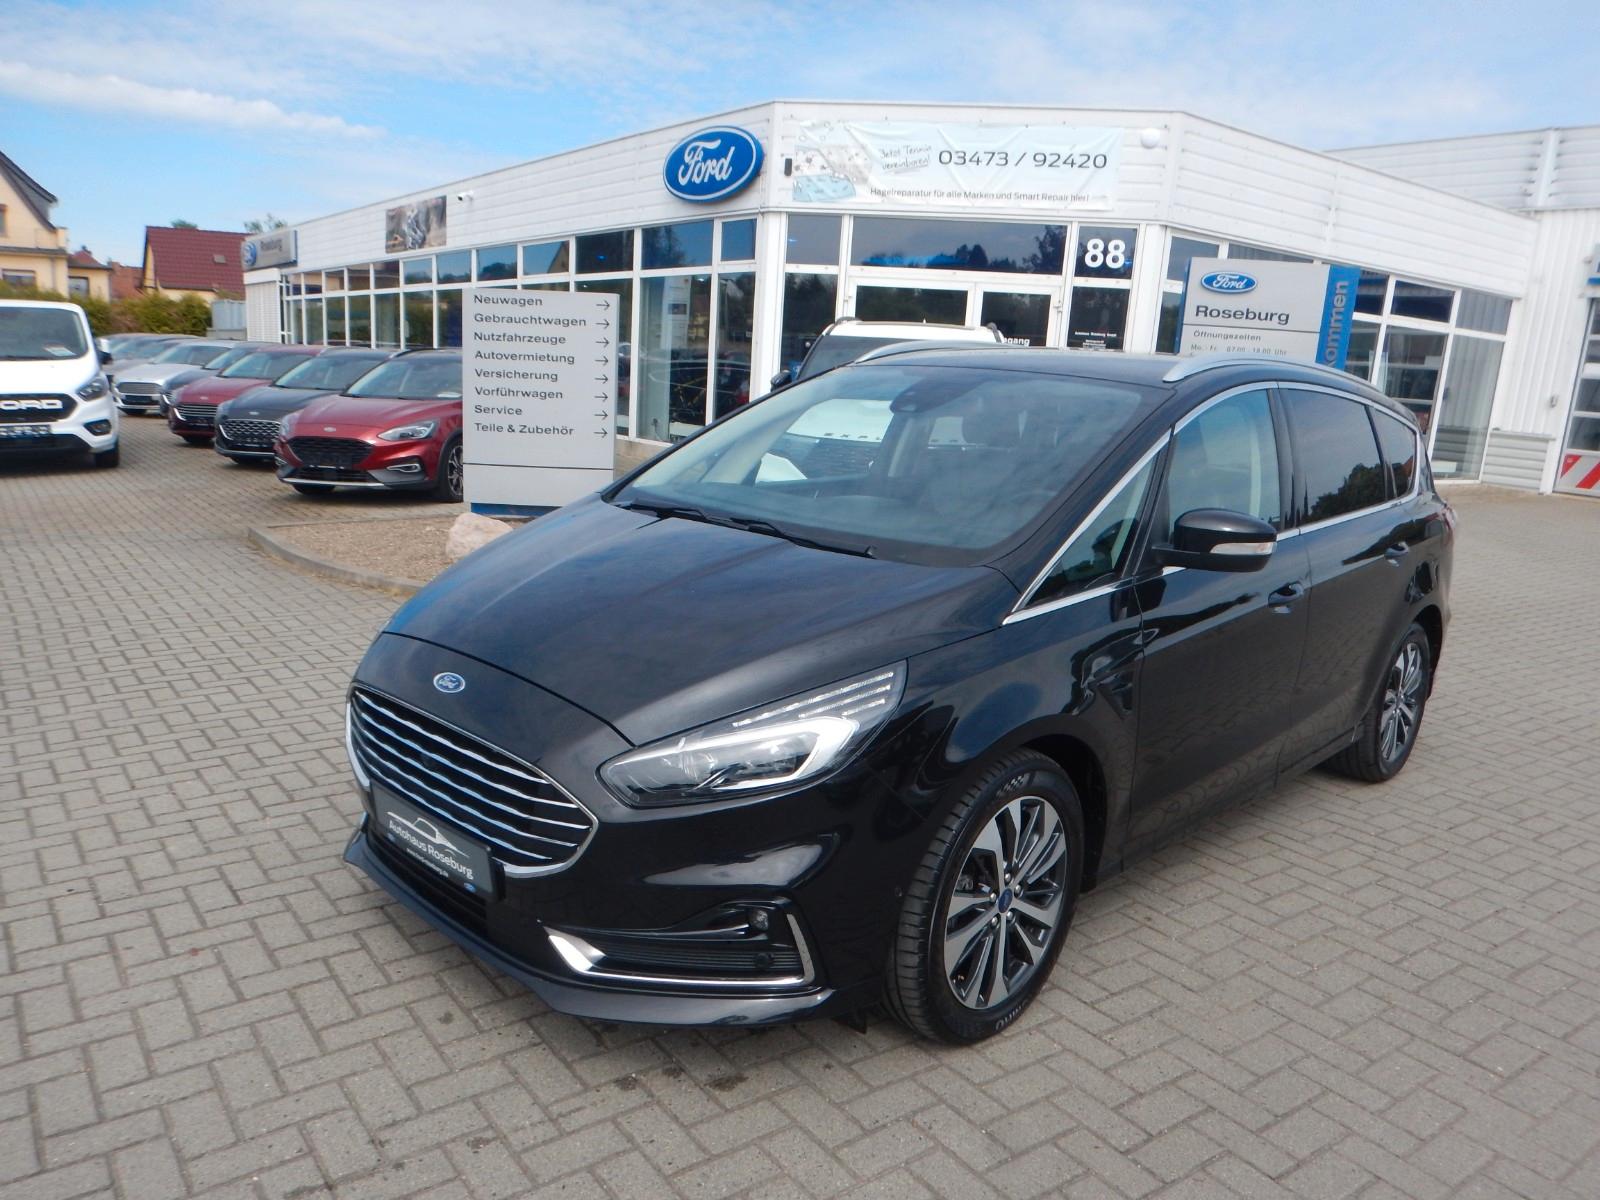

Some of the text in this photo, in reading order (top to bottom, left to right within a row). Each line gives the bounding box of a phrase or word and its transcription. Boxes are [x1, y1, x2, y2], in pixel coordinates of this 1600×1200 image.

[678, 139, 735, 186] Ford
[938, 149, 1108, 169] 03473 / 92420
[870, 187, 931, 198] Hagelreparatur
[933, 189, 945, 199] für
[946, 190, 962, 199] alle
[963, 191, 994, 200] Marken
[995, 192, 1012, 200] und
[1014, 192, 1041, 201] Smart
[1041, 193, 1069, 203] Repair
[1084, 238, 1126, 269] 88
[1212, 273, 1248, 290] Ford
[474, 294, 543, 307] Neuwagen
[474, 313, 587, 328] Gebrauchtwagen
[1195, 305, 1290, 326] Roseburg
[474, 332, 566, 346] Nutzfahrzeuge
[1193, 329, 1261, 341] Öffnungszeiten
[474, 350, 575, 365] Autovermietung
[475, 368, 558, 382] Versicherung
[475, 386, 563, 400] Vorführwagen
[474, 404, 523, 416] Service
[475, 422, 574, 436] Teile & Zubehör
[389, 819, 428, 852] Autohaus
[427, 845, 474, 881] Roseburg
